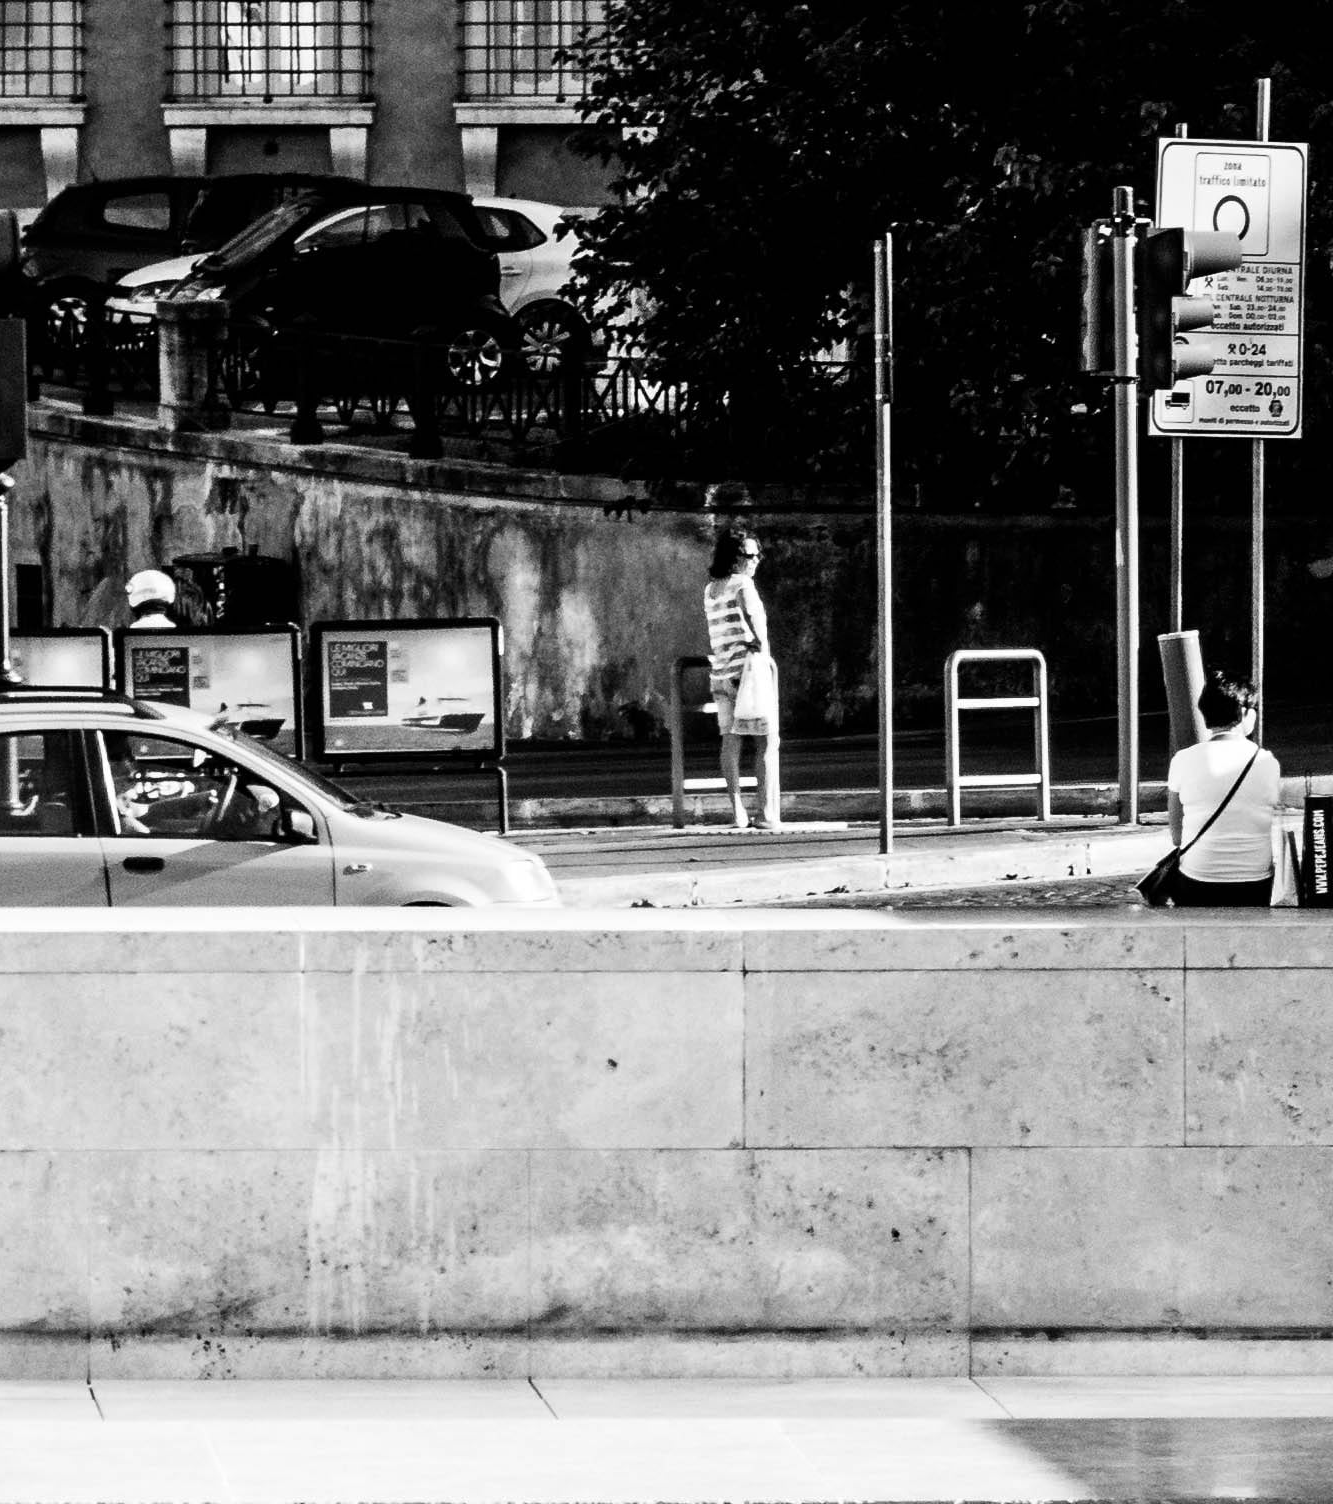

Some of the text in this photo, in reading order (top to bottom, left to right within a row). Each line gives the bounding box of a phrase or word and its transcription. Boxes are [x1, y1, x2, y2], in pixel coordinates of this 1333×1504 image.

[1199, 174, 1230, 186] traffico
[1216, 294, 1294, 303] CENTRALE NOTTURNA
[1243, 322, 1285, 331] autorizzati
[1229, 359, 1264, 368] parcheggi
[1266, 359, 1294, 367] tariffati
[1230, 404, 1261, 412] eccetto
